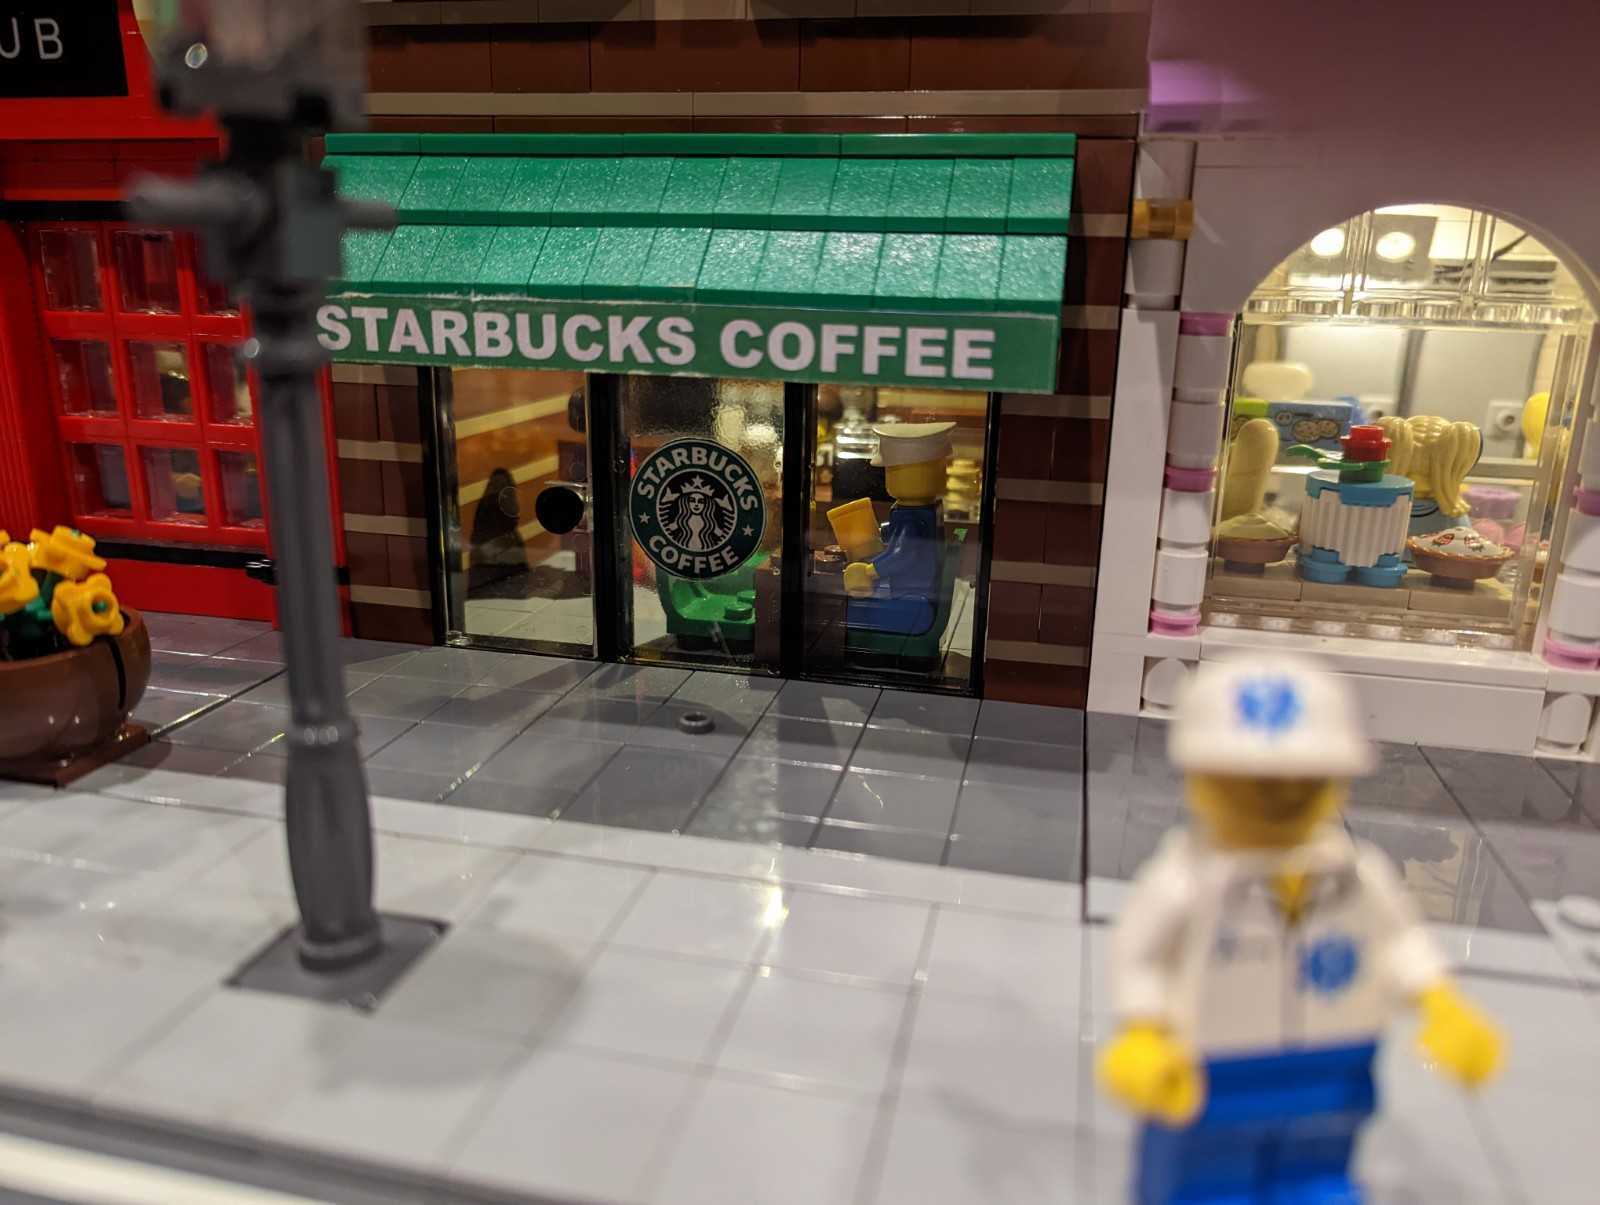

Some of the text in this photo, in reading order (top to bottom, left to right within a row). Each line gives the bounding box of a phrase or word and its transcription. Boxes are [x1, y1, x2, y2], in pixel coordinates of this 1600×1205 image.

[315, 304, 996, 380] STARBUCKS COFFEE
[637, 446, 759, 511] STARBUCKS
[649, 534, 740, 575] COFFEE
